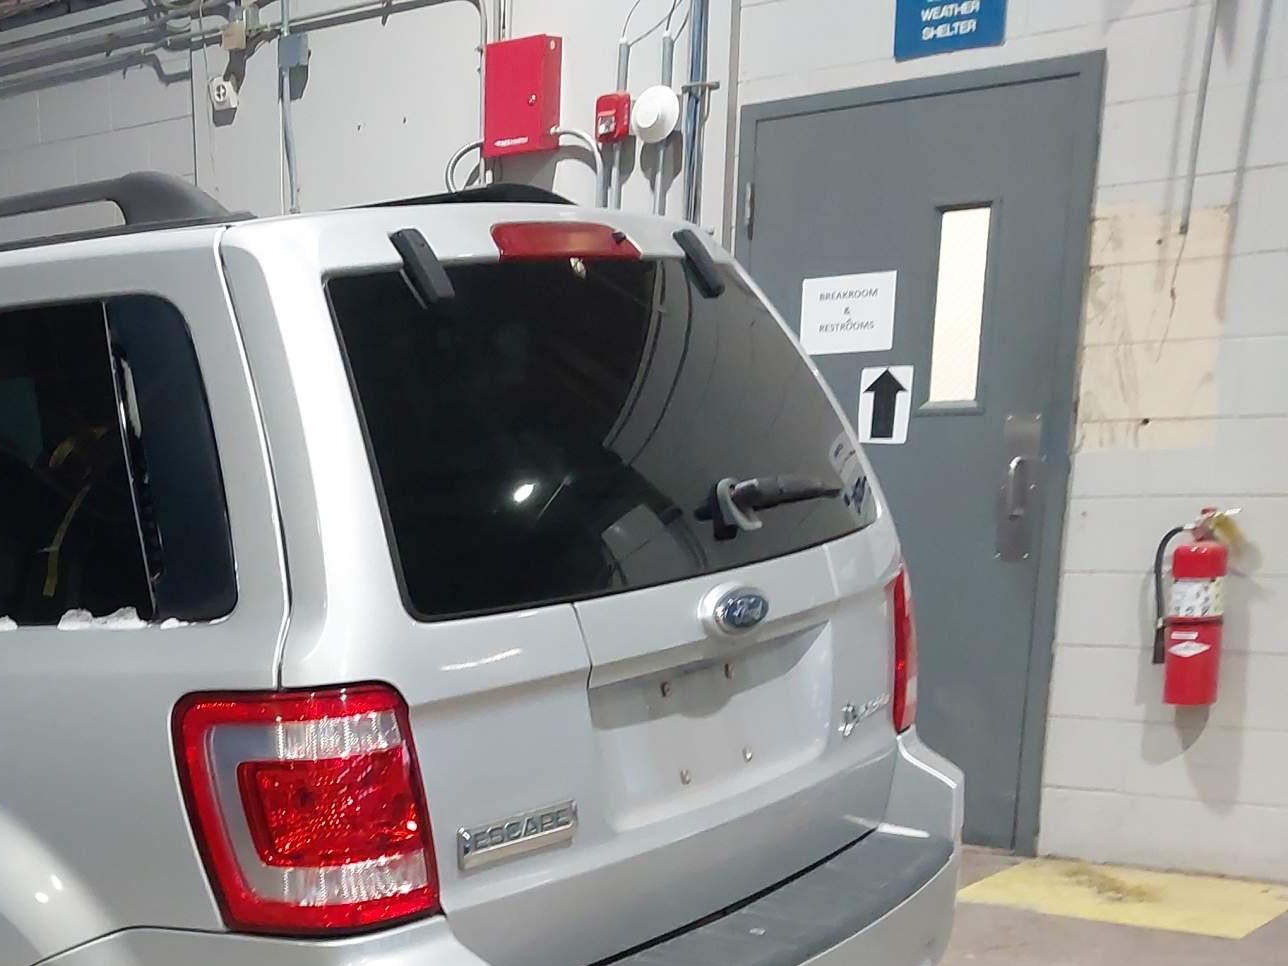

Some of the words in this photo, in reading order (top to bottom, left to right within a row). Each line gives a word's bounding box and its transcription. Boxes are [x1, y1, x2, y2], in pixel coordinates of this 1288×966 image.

[920, 0, 981, 21] WEATHER
[921, 19, 977, 40] SHELTER
[819, 288, 879, 301] BREAKROOM
[818, 320, 874, 333] RESTROOMS
[472, 807, 571, 849] ESCAPE
